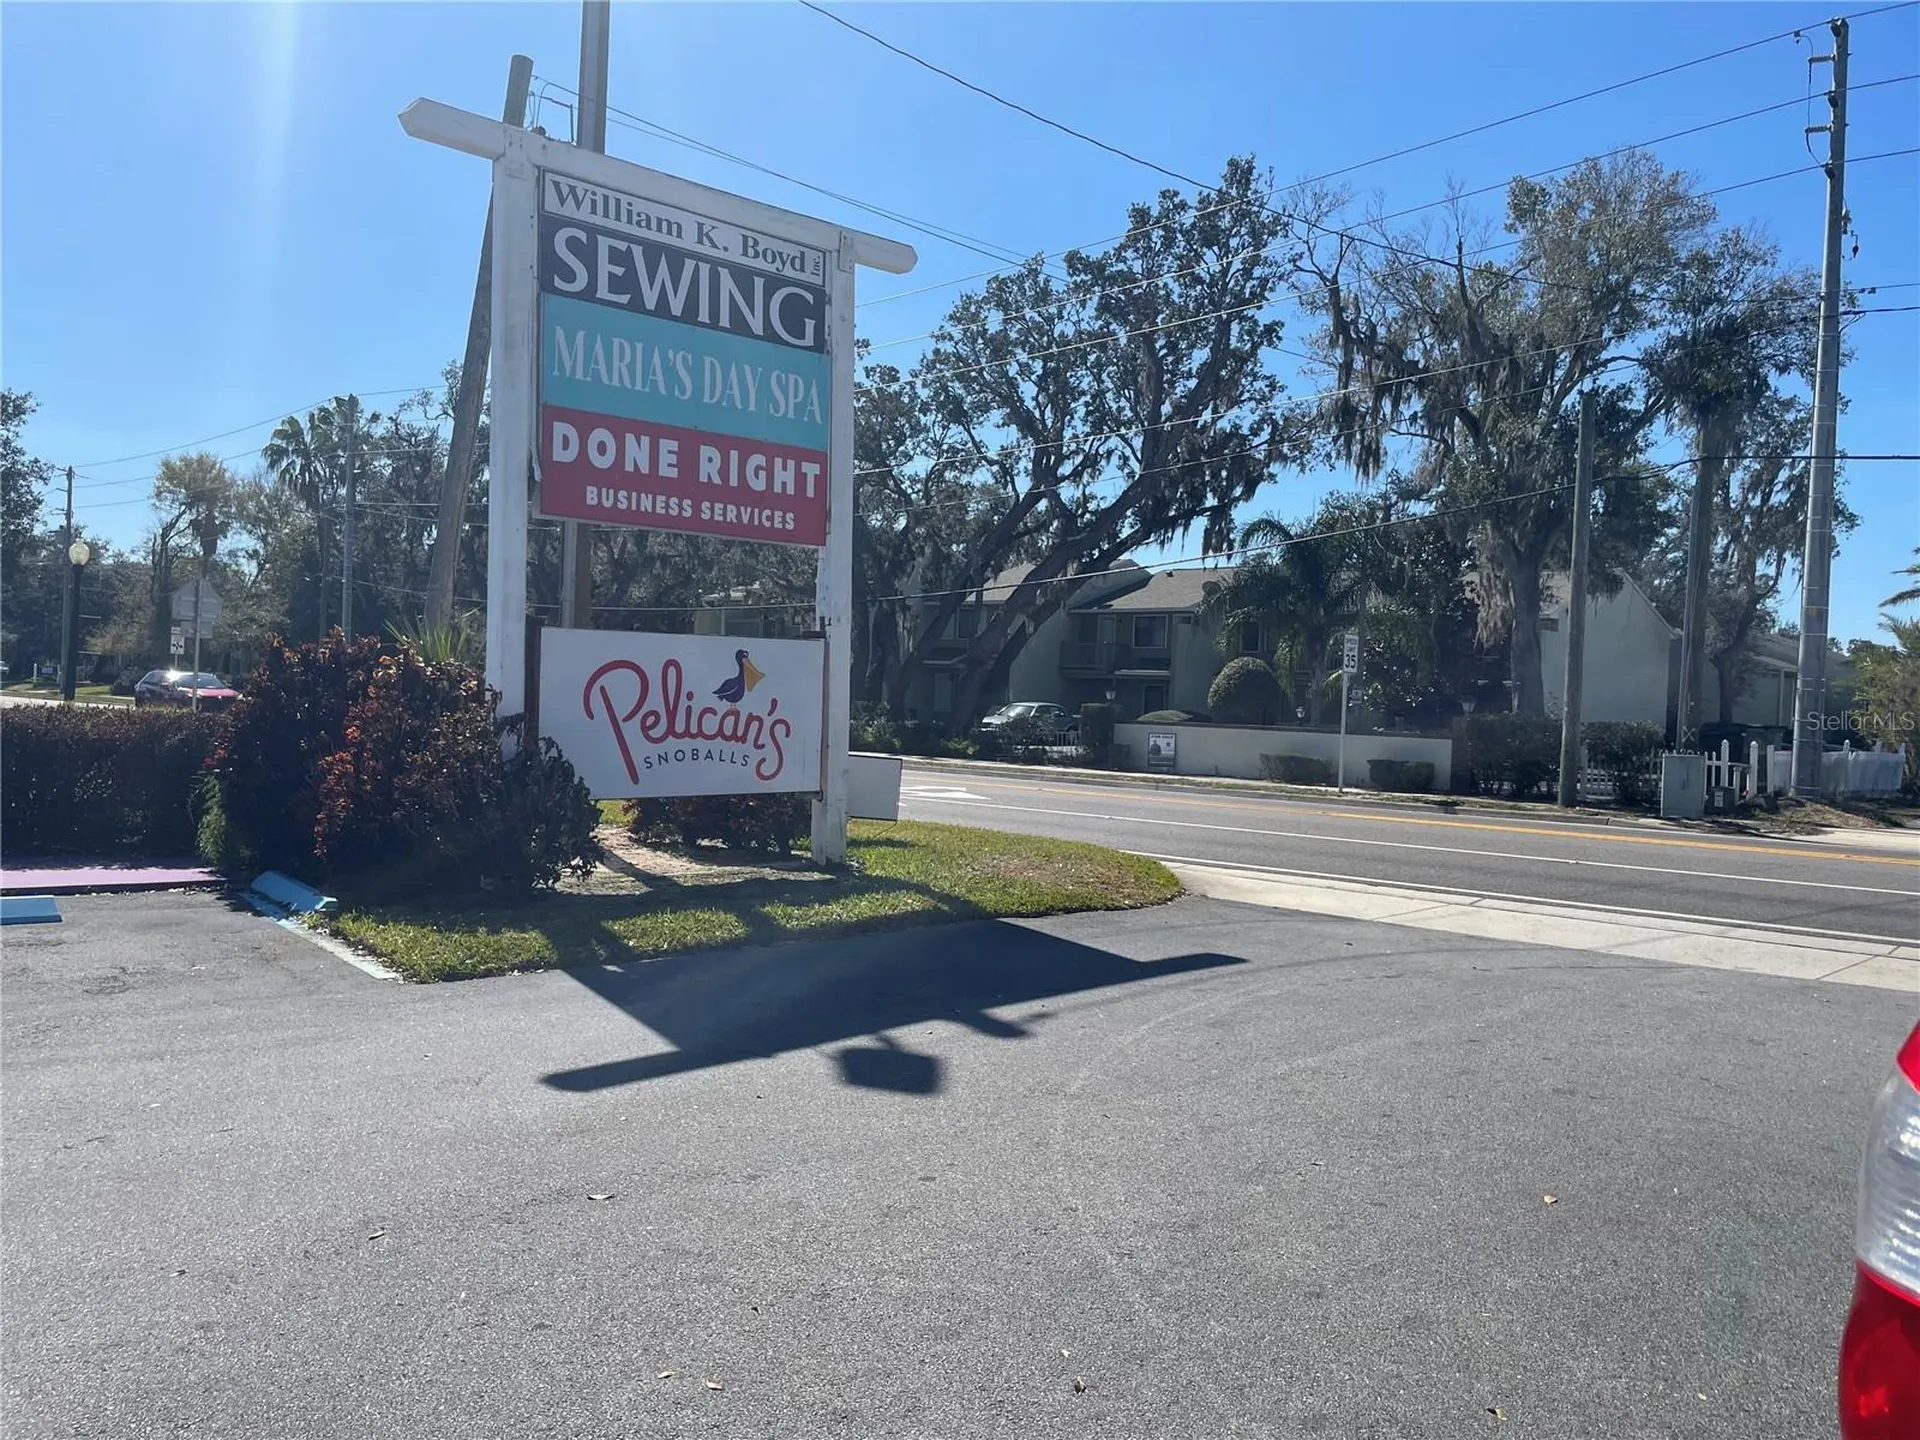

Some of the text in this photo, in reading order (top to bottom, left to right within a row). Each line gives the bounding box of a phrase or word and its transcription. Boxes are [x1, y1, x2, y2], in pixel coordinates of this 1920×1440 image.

[550, 180, 807, 273] William K. Boyd
[553, 226, 816, 347] SEWING
[552, 325, 824, 424] MARIA'S DAY SPA
[552, 421, 821, 498] DONE RIGHT
[586, 486, 795, 530] BUSINESS SERVICES
[1345, 654, 1356, 668] 35
[583, 658, 791, 785] Pelican's
[644, 749, 750, 769] SNOBALLS
